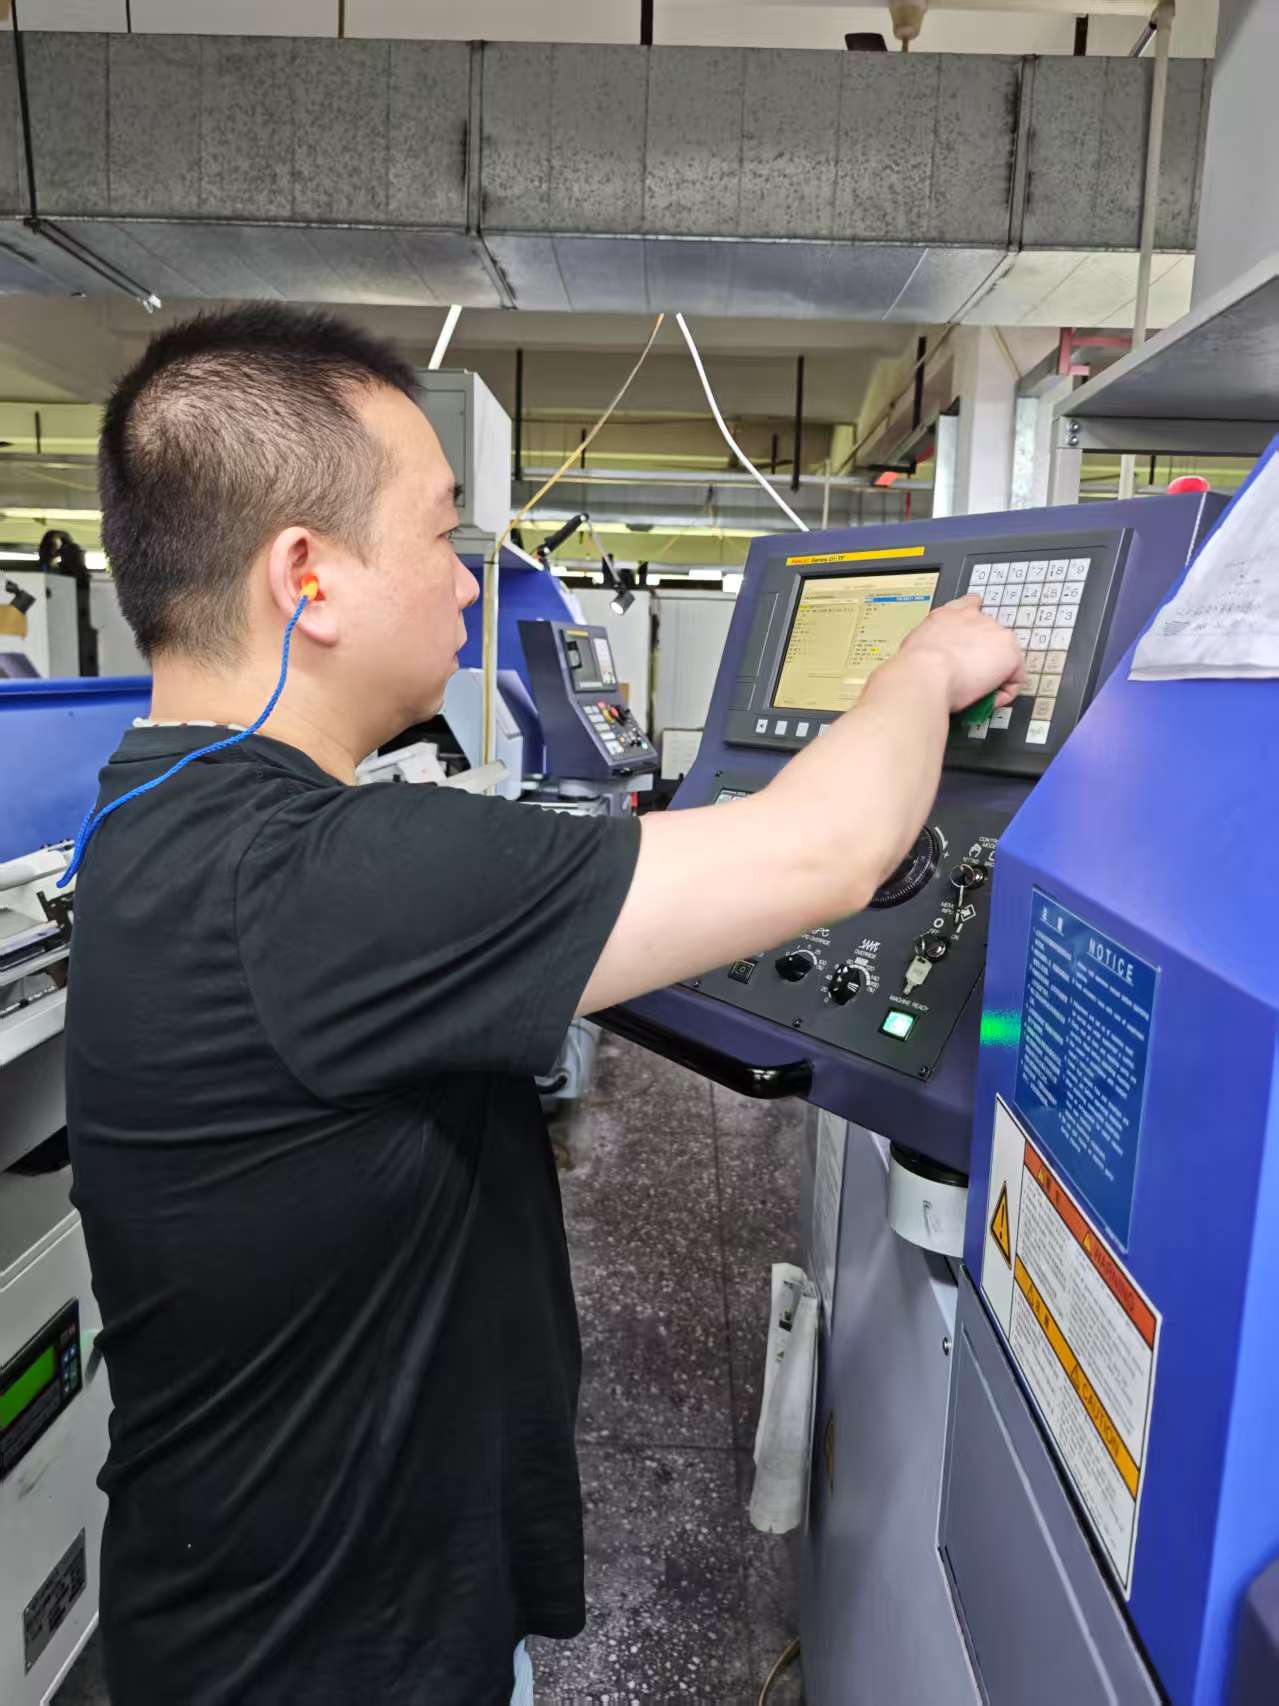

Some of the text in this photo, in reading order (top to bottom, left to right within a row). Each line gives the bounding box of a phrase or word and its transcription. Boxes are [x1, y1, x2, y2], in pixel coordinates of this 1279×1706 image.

[1088, 938, 1134, 984] NOTICE
[1090, 1247, 1135, 1311] WARNING
[1081, 1383, 1119, 1456] CAUTION
